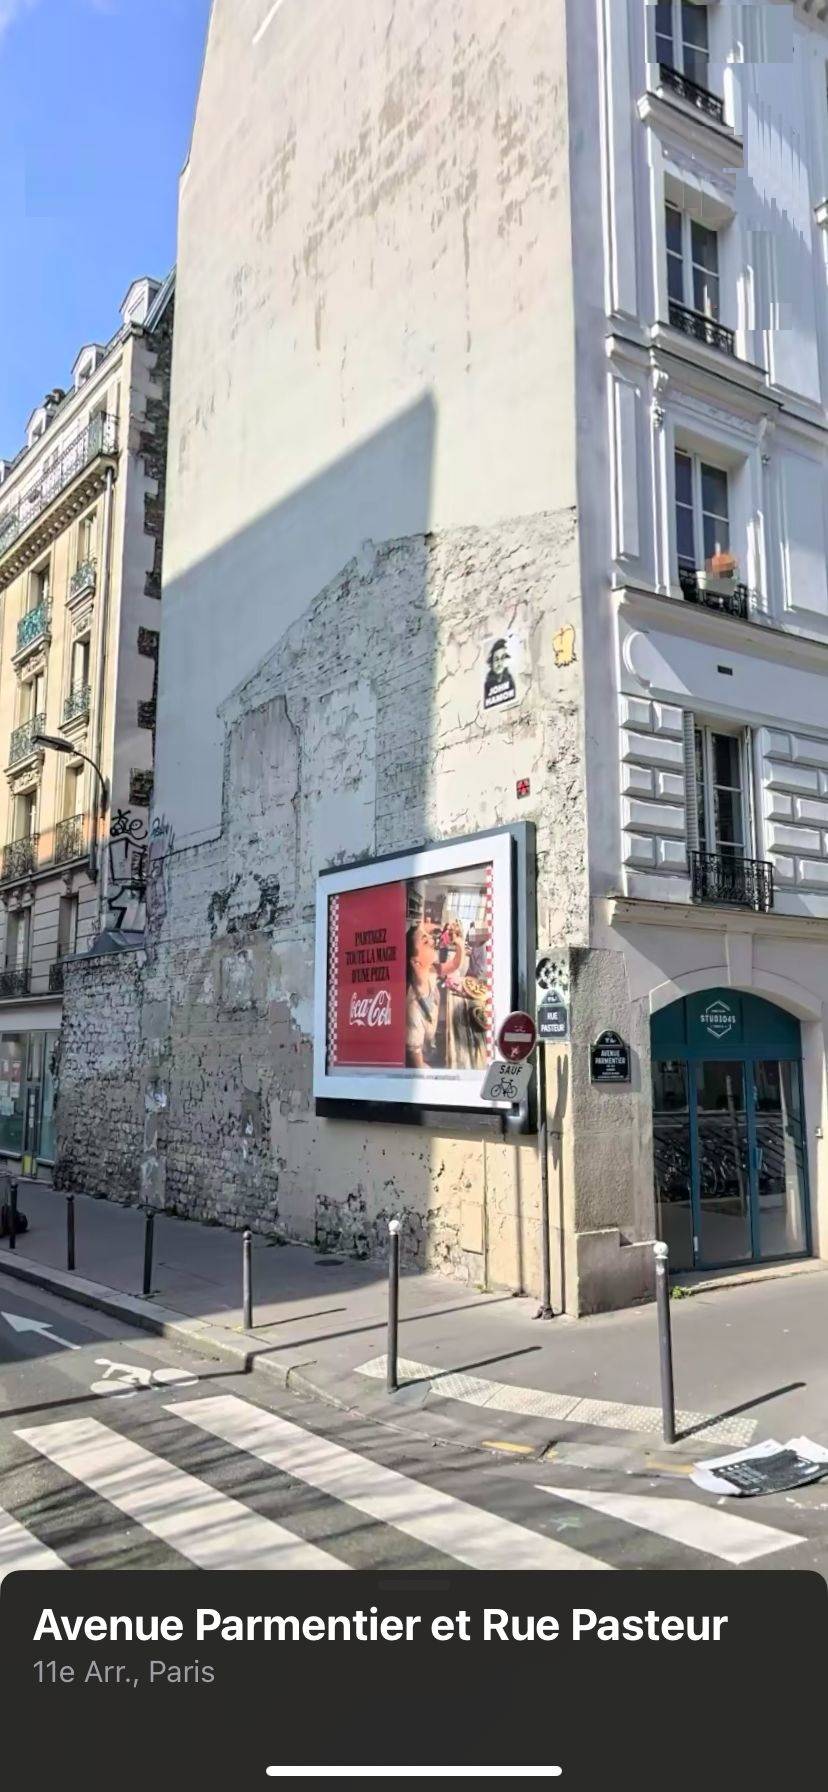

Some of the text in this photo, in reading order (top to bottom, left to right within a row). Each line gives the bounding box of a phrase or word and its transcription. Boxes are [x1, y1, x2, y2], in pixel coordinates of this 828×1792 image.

[488, 681, 510, 696] JOHN
[485, 689, 515, 706] HAMON
[355, 928, 387, 946] PARTAGEZ
[345, 946, 396, 965] TOUTE LA MAGIE
[352, 966, 390, 984] D'UNE PIZZA
[547, 1012, 558, 1020] RUE
[541, 1023, 565, 1032] PASTEUR
[500, 1065, 523, 1076] SAUF
